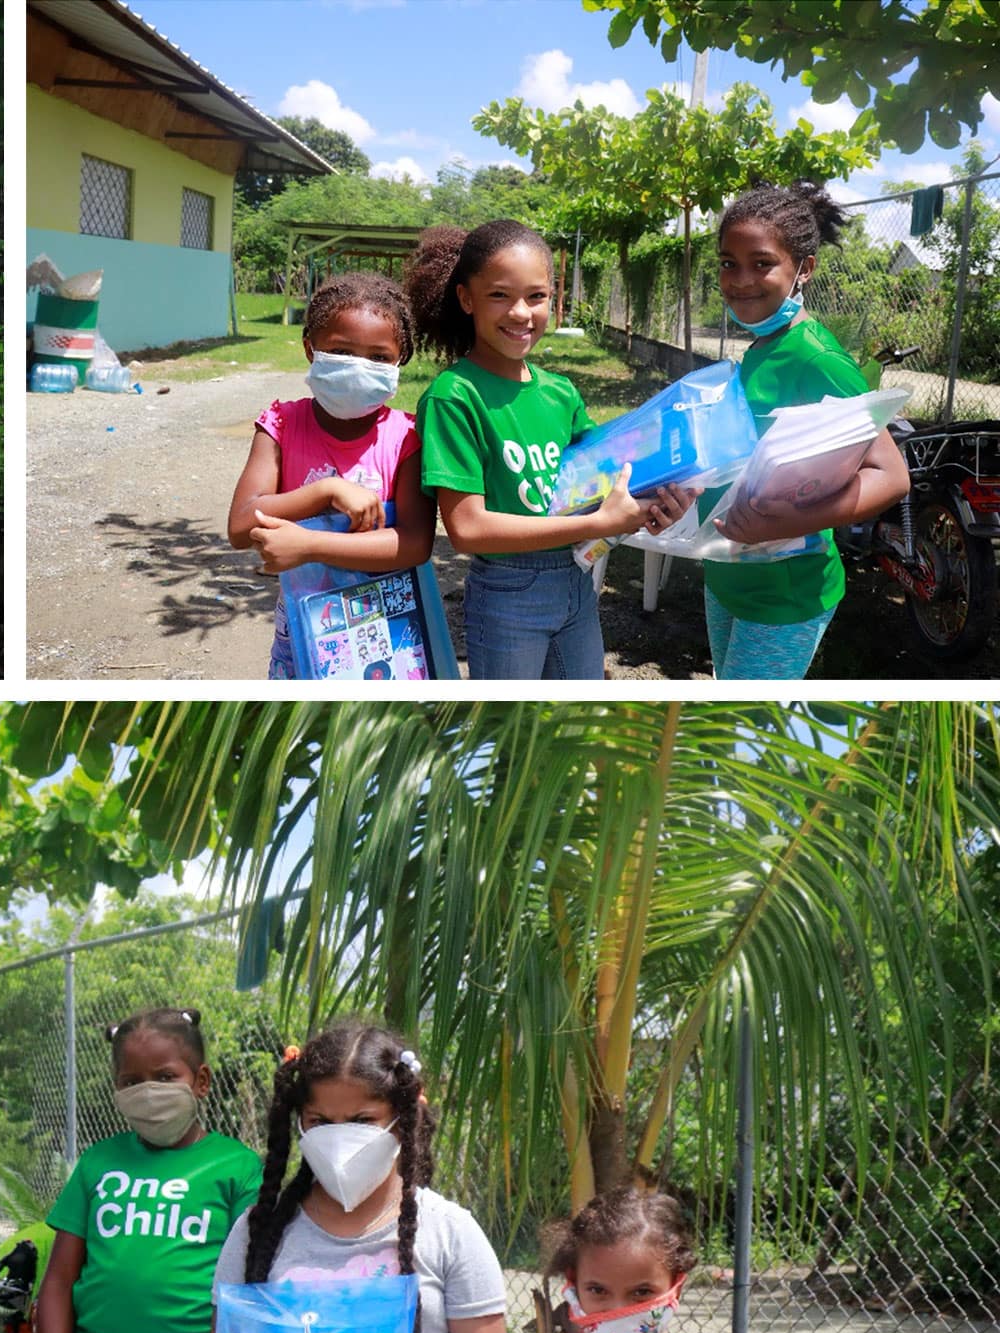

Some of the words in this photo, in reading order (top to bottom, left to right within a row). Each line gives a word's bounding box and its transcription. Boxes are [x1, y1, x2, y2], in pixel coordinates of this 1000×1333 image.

[503, 439, 560, 474] One
[96, 1170, 190, 1200] One
[96, 1202, 211, 1244] Child
